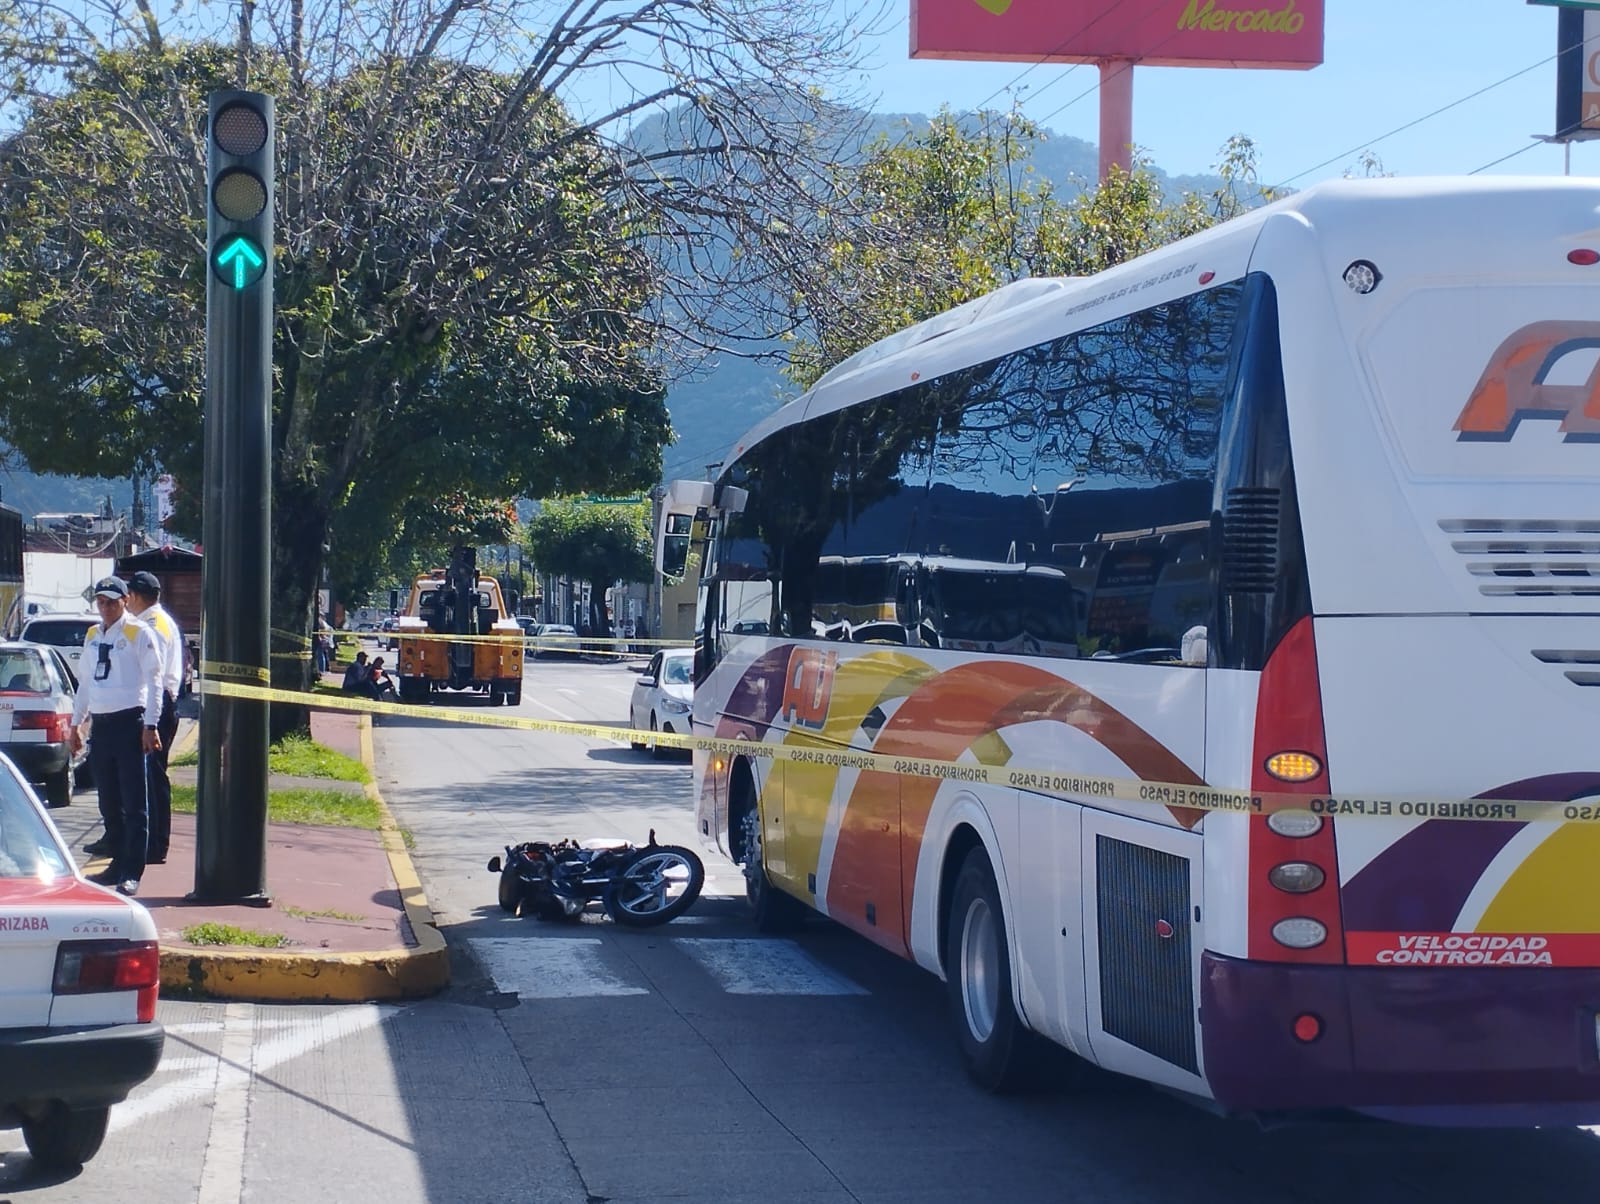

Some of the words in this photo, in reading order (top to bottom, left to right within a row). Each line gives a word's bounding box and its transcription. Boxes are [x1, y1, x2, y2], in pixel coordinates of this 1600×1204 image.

[1177, 0, 1304, 34] Mercado
[1399, 935, 1548, 950] VELOCIDAD
[1376, 950, 1553, 965] CONTROLADA
